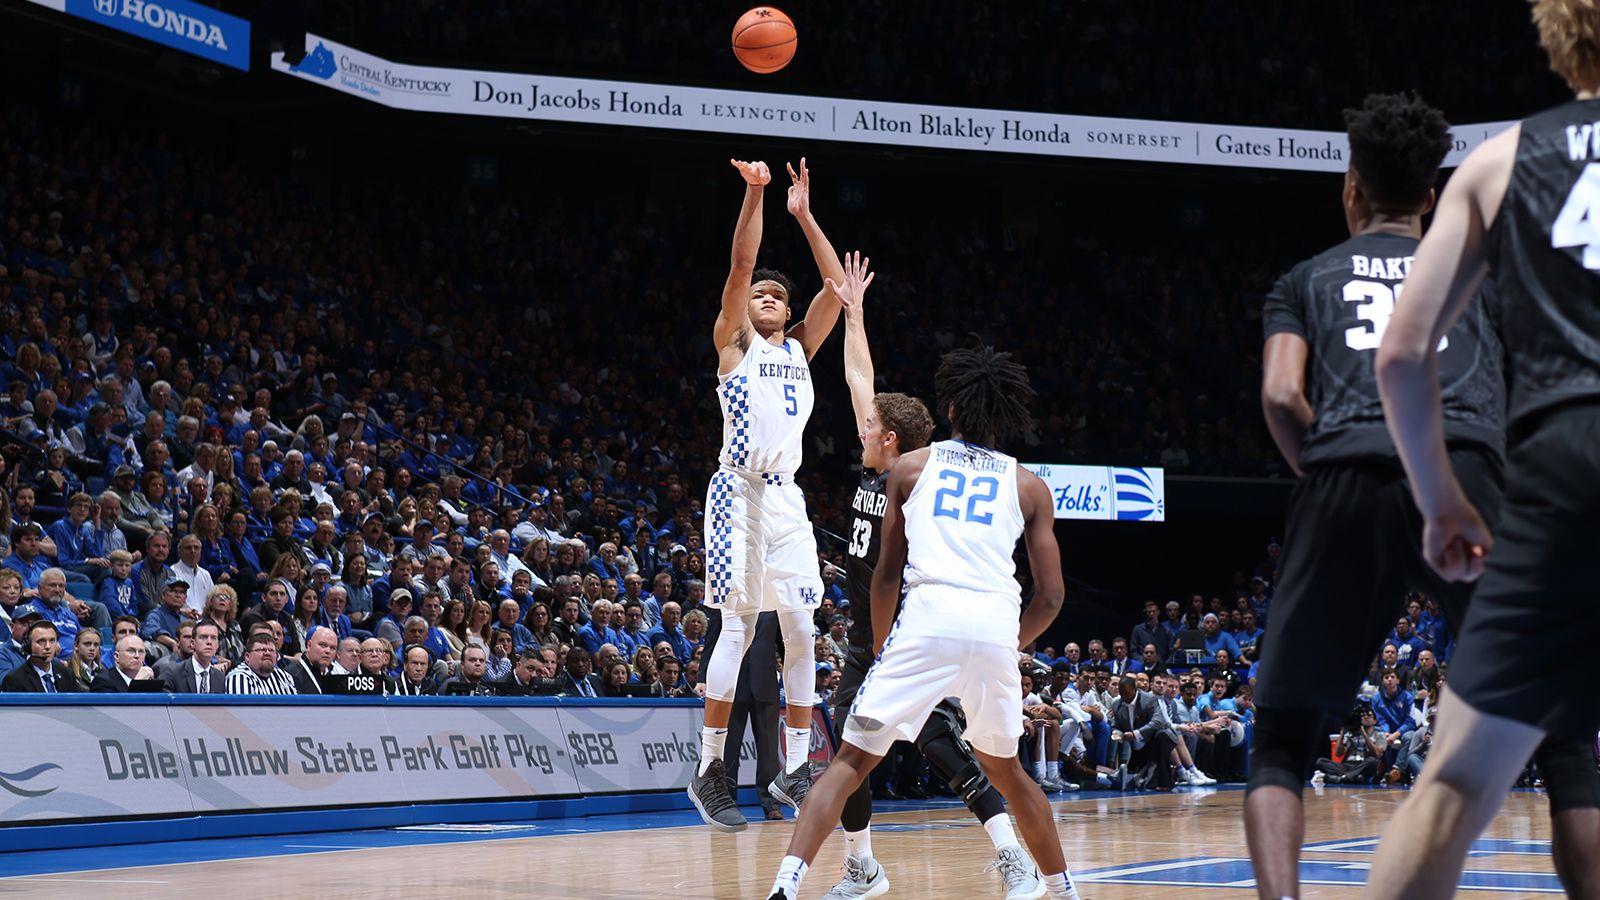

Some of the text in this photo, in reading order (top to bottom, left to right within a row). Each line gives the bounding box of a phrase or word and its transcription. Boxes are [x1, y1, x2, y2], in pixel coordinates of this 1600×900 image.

[121, 0, 228, 50] HONDA
[341, 55, 451, 92] CENTRAL KENTUCKY
[473, 80, 683, 116] Don Jacobs Honda
[701, 103, 816, 123] LEXINGTON
[852, 110, 1071, 145] Alton Blakley Honda
[1087, 131, 1181, 148] SOMERSET
[1215, 134, 1342, 161] Gates Honda
[783, 384, 797, 416] 5
[934, 469, 1000, 525] 22
[848, 517, 872, 558] 33
[348, 676, 375, 691] POSS
[99, 739, 180, 780] Dale
[183, 738, 289, 777] Hollow
[295, 736, 378, 774] State
[380, 735, 449, 771] Park
[450, 734, 501, 769] Golf
[504, 734, 554, 774] Pkg
[568, 730, 619, 768] $68
